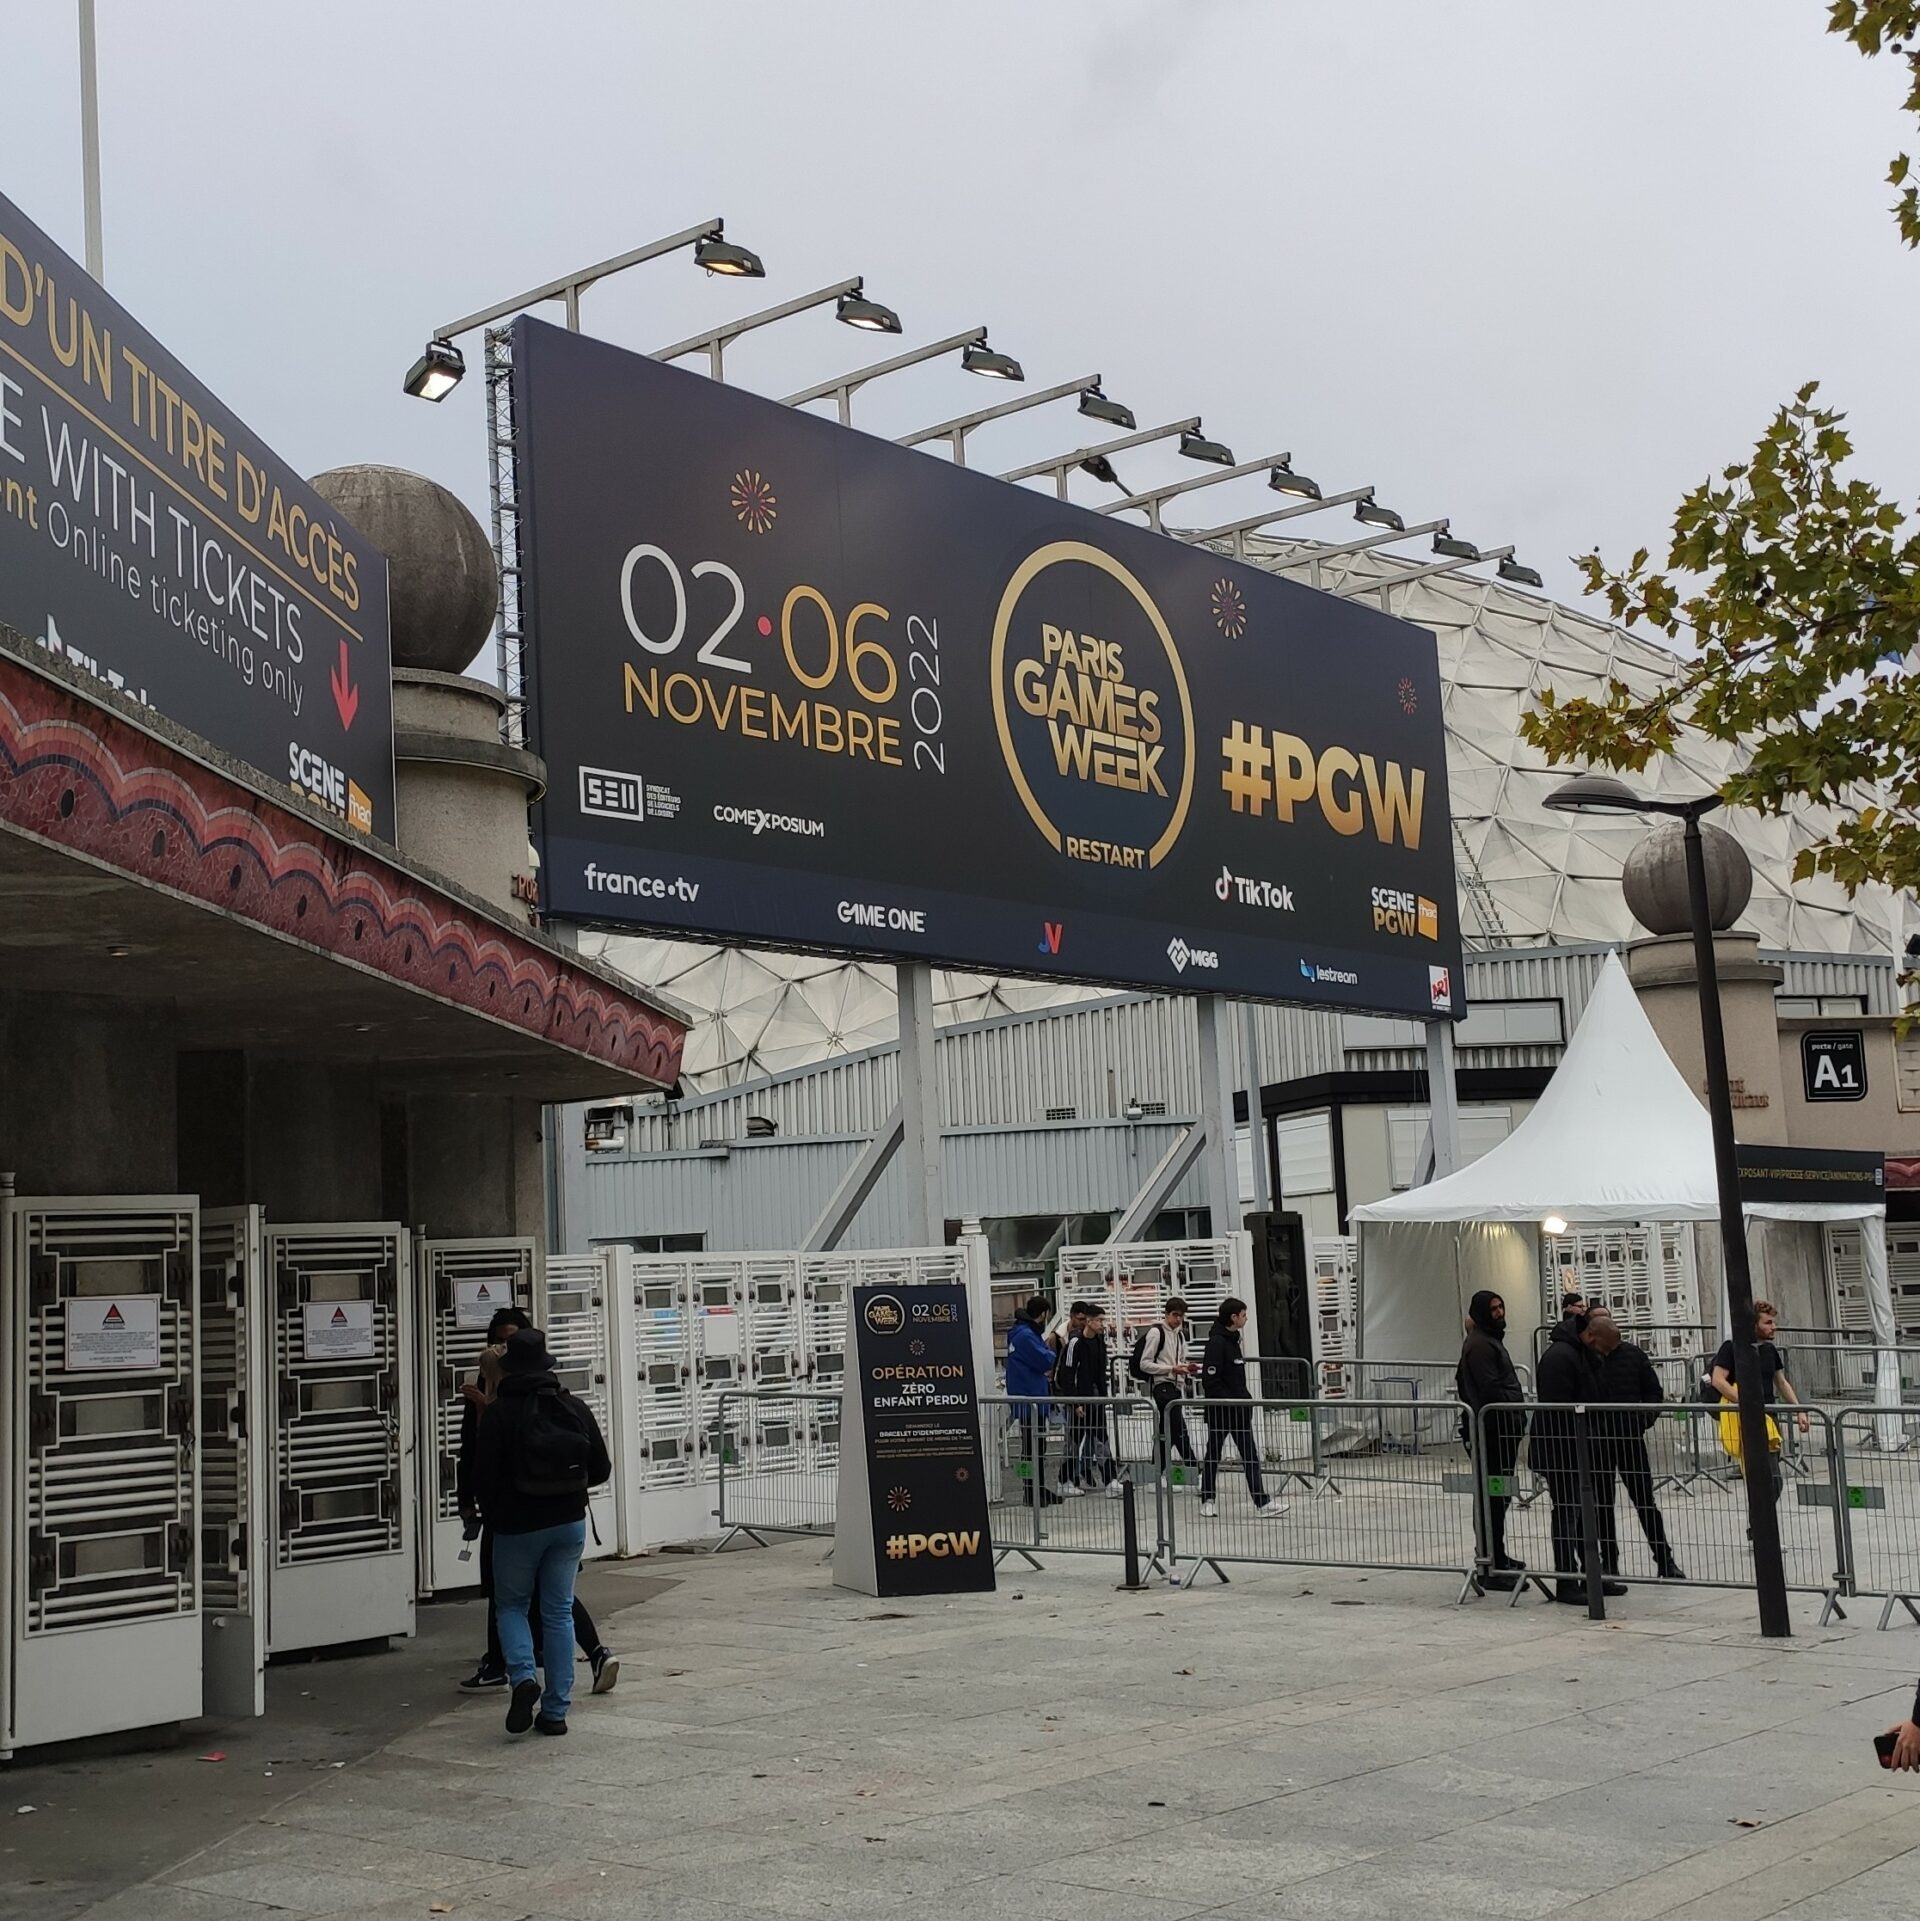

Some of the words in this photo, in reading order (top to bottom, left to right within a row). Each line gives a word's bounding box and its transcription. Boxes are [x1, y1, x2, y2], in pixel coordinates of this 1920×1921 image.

[0, 233, 111, 403] D'UN
[122, 346, 227, 502] TITRE
[237, 451, 360, 611] D'ACCÈS
[41, 405, 155, 558] WITH
[168, 506, 304, 664] TICKETS
[0, 477, 38, 530] nt
[48, 501, 141, 599] Online
[150, 574, 254, 686] ticketing
[263, 661, 303, 717] only
[1042, 623, 1125, 683] PARIS
[907, 614, 946, 775] 2022
[1014, 658, 1162, 744] GAMES
[623, 661, 903, 767] NOVEMBRE
[289, 741, 345, 809] SCENE
[1047, 719, 1169, 798] WEEK
[1220, 719, 1426, 851] #PGW
[713, 805, 825, 837] COMEXPOSIUM
[1067, 836, 1145, 869] RESTART
[1235, 876, 1296, 912] TikTok
[1371, 886, 1415, 914] SCENE
[837, 900, 886, 929] GAME
[888, 908, 926, 934] ONE
[1373, 906, 1415, 937] PGW
[1191, 949, 1219, 969] MGG
[1316, 965, 1358, 985] lestream
[1814, 1054, 1859, 1088] A1
[912, 1304, 929, 1317] 02
[932, 1304, 951, 1317] 06
[872, 1364, 964, 1380] OPÉRATION
[873, 1396, 923, 1408] ENFANT
[926, 1394, 968, 1406] PERDU
[885, 1530, 980, 1560] #PGW
